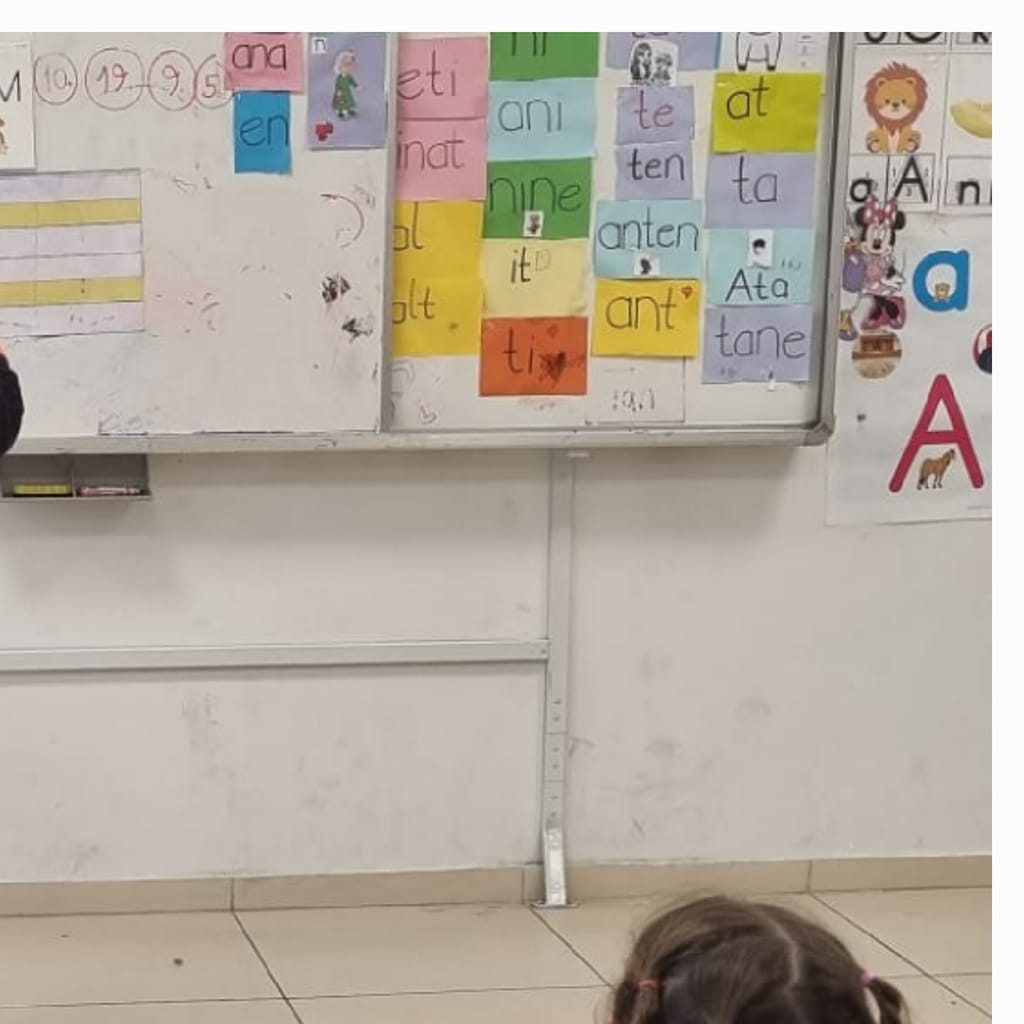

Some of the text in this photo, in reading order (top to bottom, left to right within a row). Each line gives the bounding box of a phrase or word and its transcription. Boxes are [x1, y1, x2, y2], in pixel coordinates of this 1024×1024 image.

[231, 43, 288, 71] ana
[396, 48, 456, 100] eti
[497, 99, 563, 133] ani
[633, 89, 674, 130] te
[725, 77, 769, 121] at
[239, 116, 290, 147] en
[396, 128, 465, 171] inat
[627, 147, 686, 181] ten
[731, 155, 778, 205] ta
[489, 176, 582, 214] nine
[597, 206, 699, 252] anten
[725, 268, 790, 301] Ata
[912, 249, 971, 312] a
[605, 287, 678, 332] ant
[503, 327, 535, 375] ti
[714, 315, 807, 360] tane
[887, 373, 985, 493] A
